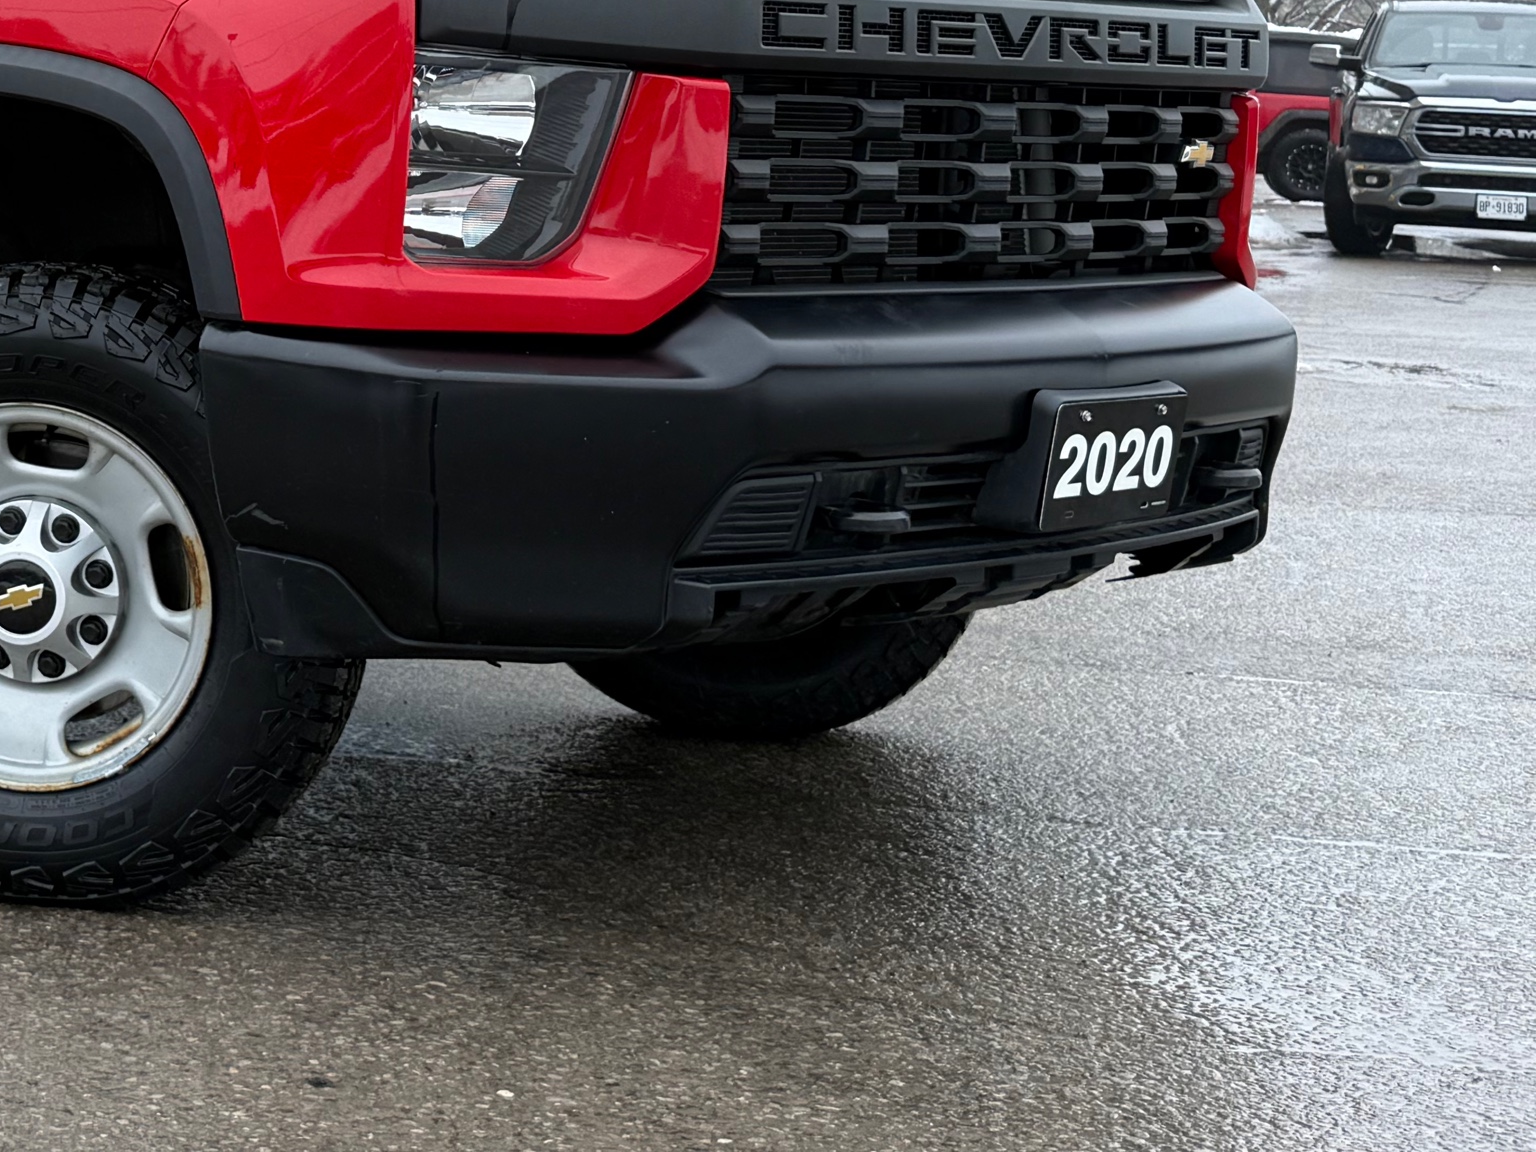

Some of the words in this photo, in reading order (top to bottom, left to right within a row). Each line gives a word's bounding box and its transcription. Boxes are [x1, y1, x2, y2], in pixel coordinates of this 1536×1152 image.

[761, 0, 1263, 71] CHEVROLET
[1467, 126, 1536, 140] RAM
[1052, 424, 1174, 500] 2020
